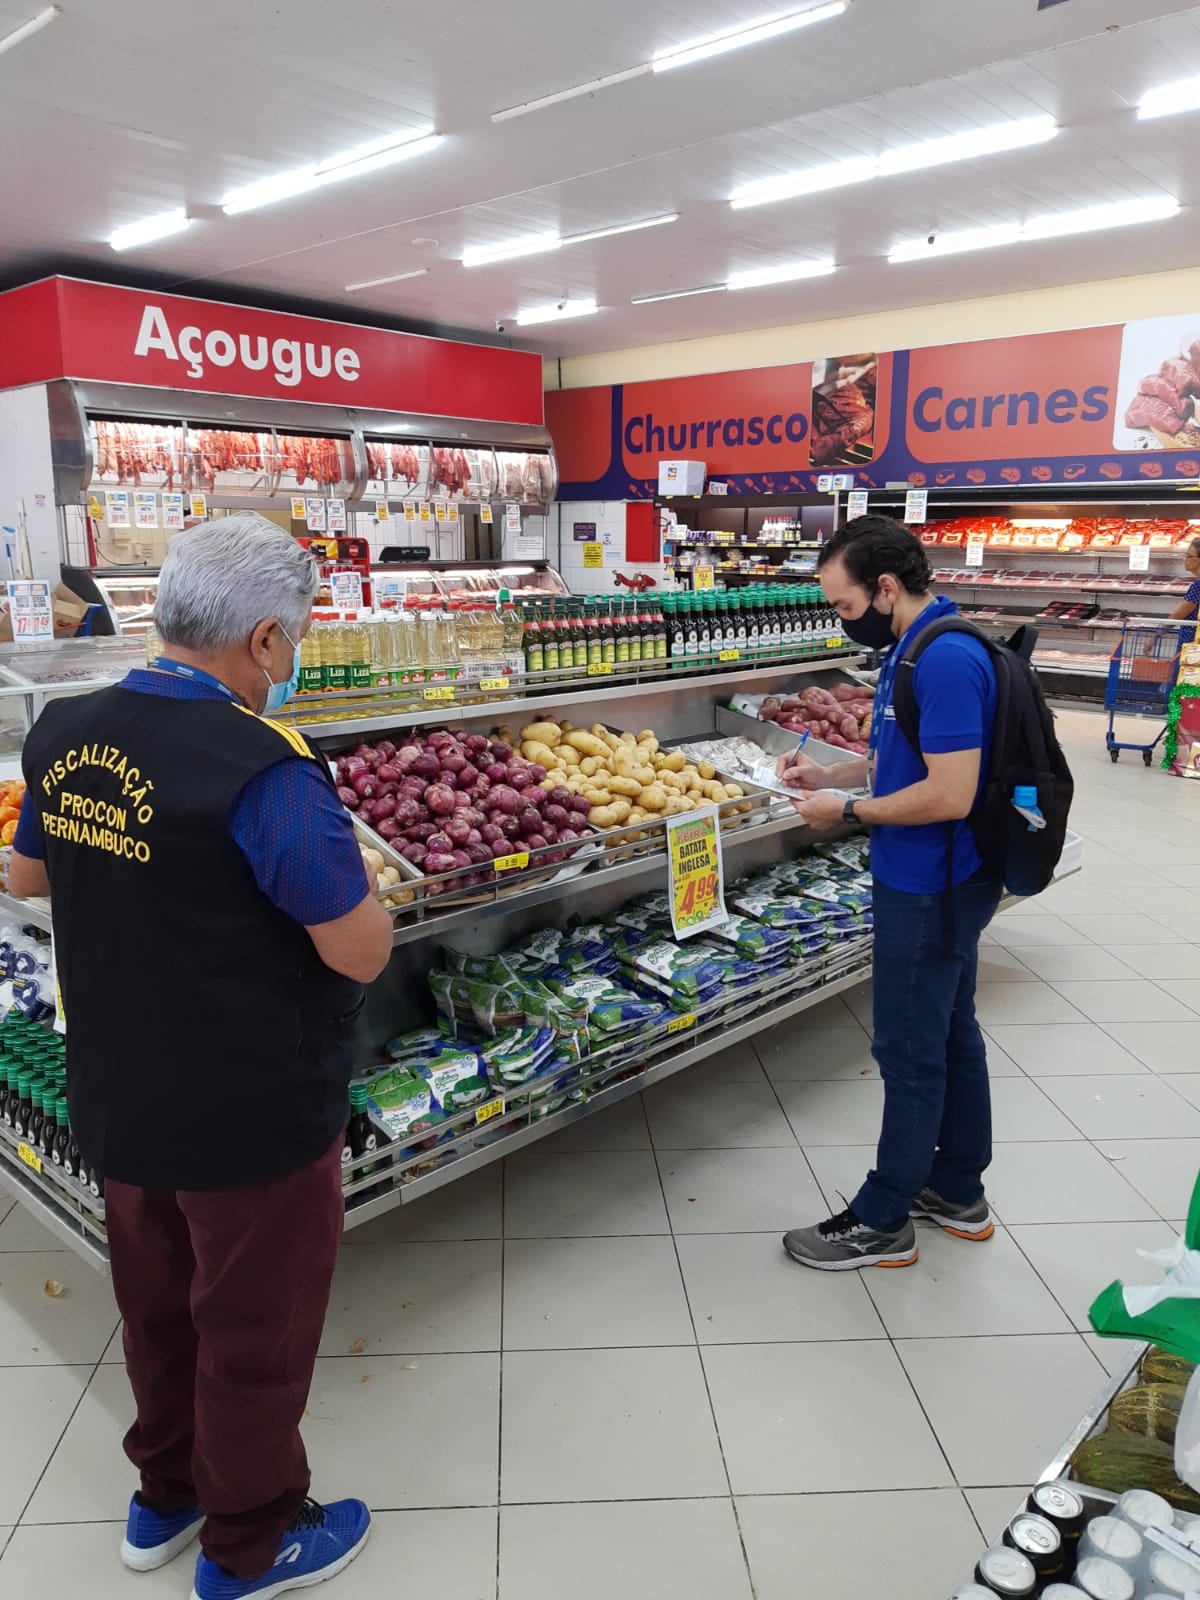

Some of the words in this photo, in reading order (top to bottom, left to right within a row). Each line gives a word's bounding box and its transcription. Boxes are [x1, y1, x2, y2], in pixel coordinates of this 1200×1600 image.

[134, 305, 361, 387] Açougue
[913, 385, 1109, 433] Carnes
[625, 411, 808, 455] Churrasco
[42, 744, 154, 824] FISCALIZAÇÃO
[61, 791, 127, 832] PROCON
[42, 811, 151, 863] PERNAMBUCO
[679, 839, 707, 859] BATATA
[678, 853, 711, 875] INGLESA
